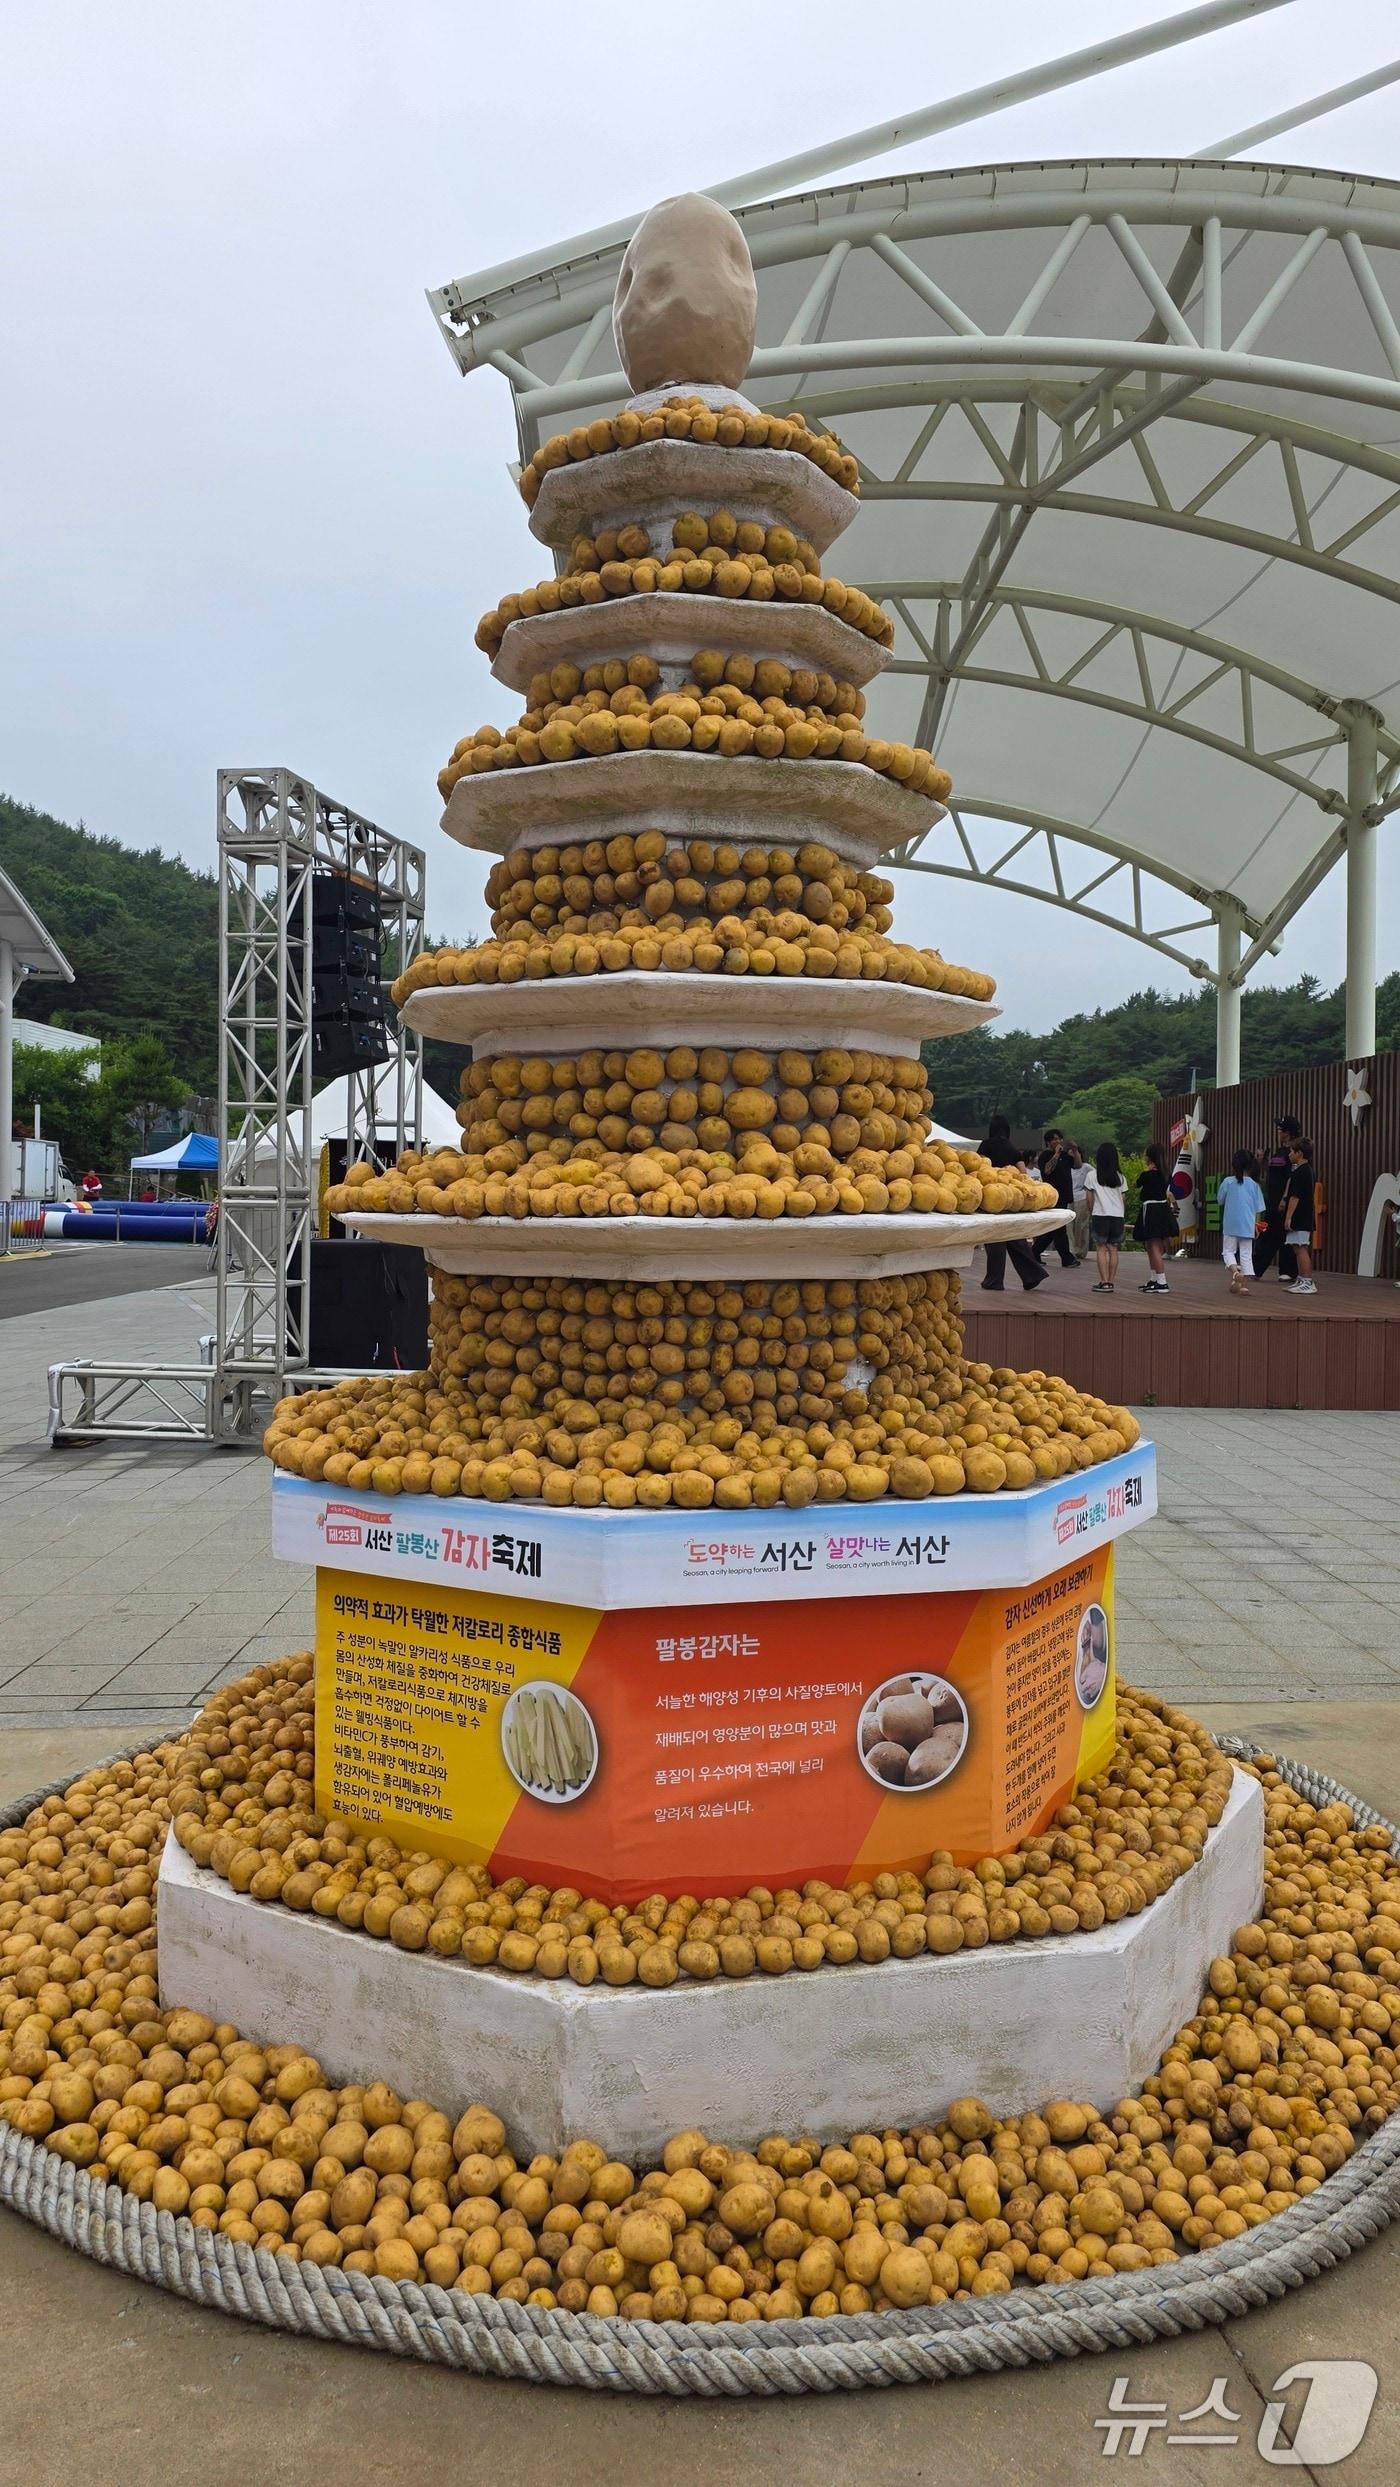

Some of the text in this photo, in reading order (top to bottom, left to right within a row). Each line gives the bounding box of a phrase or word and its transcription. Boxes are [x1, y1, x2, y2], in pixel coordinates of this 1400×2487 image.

[1076, 1510, 1088, 1534] 서산
[328, 1528, 359, 1542] 제25회
[365, 1528, 393, 1551] 서산
[396, 1531, 439, 1560] 팔봉산
[688, 1535, 950, 1571] 도약하는 서산 살맛나는 서산
[716, 1568, 728, 1576] city
[728, 1567, 752, 1575] leaping
[858, 1561, 870, 1569] city
[891, 1559, 908, 1567] living
[1005, 1563, 1093, 1630] 감자 신선하게 오래 보관하기
[334, 1595, 561, 1655] 의약적 효과가 탁월한 저칼로리 종합식품
[336, 1631, 515, 1678] 주 성분이 녹말인 알카리성 식품으로 우리
[655, 1634, 760, 1662] 팔봉감자는
[336, 1649, 511, 1696] 몸의 산성화 체질을 중화하여 건강체질로
[336, 1668, 488, 1713] 만들며, 저칼로리식품으로 체지방을
[655, 1681, 863, 1710] 서늘한 해양성 기후의 사질양토에서
[335, 1687, 480, 1729] 흡수하면 걱정없이 다이어트 할 수
[335, 1705, 416, 1734] 있는 웰빙식품이다.
[334, 1724, 444, 1761] 비타민C가 풍부하여 감기,
[655, 1719, 837, 1748] 재배되어 영양분이 많으며 맛과
[334, 1743, 448, 1781] 뇌출혈, 위궤양 예방효과와
[654, 1758, 824, 1785] 품질이 우수하여 전국에 널리
[334, 1761, 441, 1799] 생감자에는 폴리페놀유가
[332, 1799, 383, 1823] 효능이 있다.
[333, 1780, 453, 1821] 함유되어 있어 혈압예방에도
[654, 1800, 754, 1823] 알려져 있습니다.
